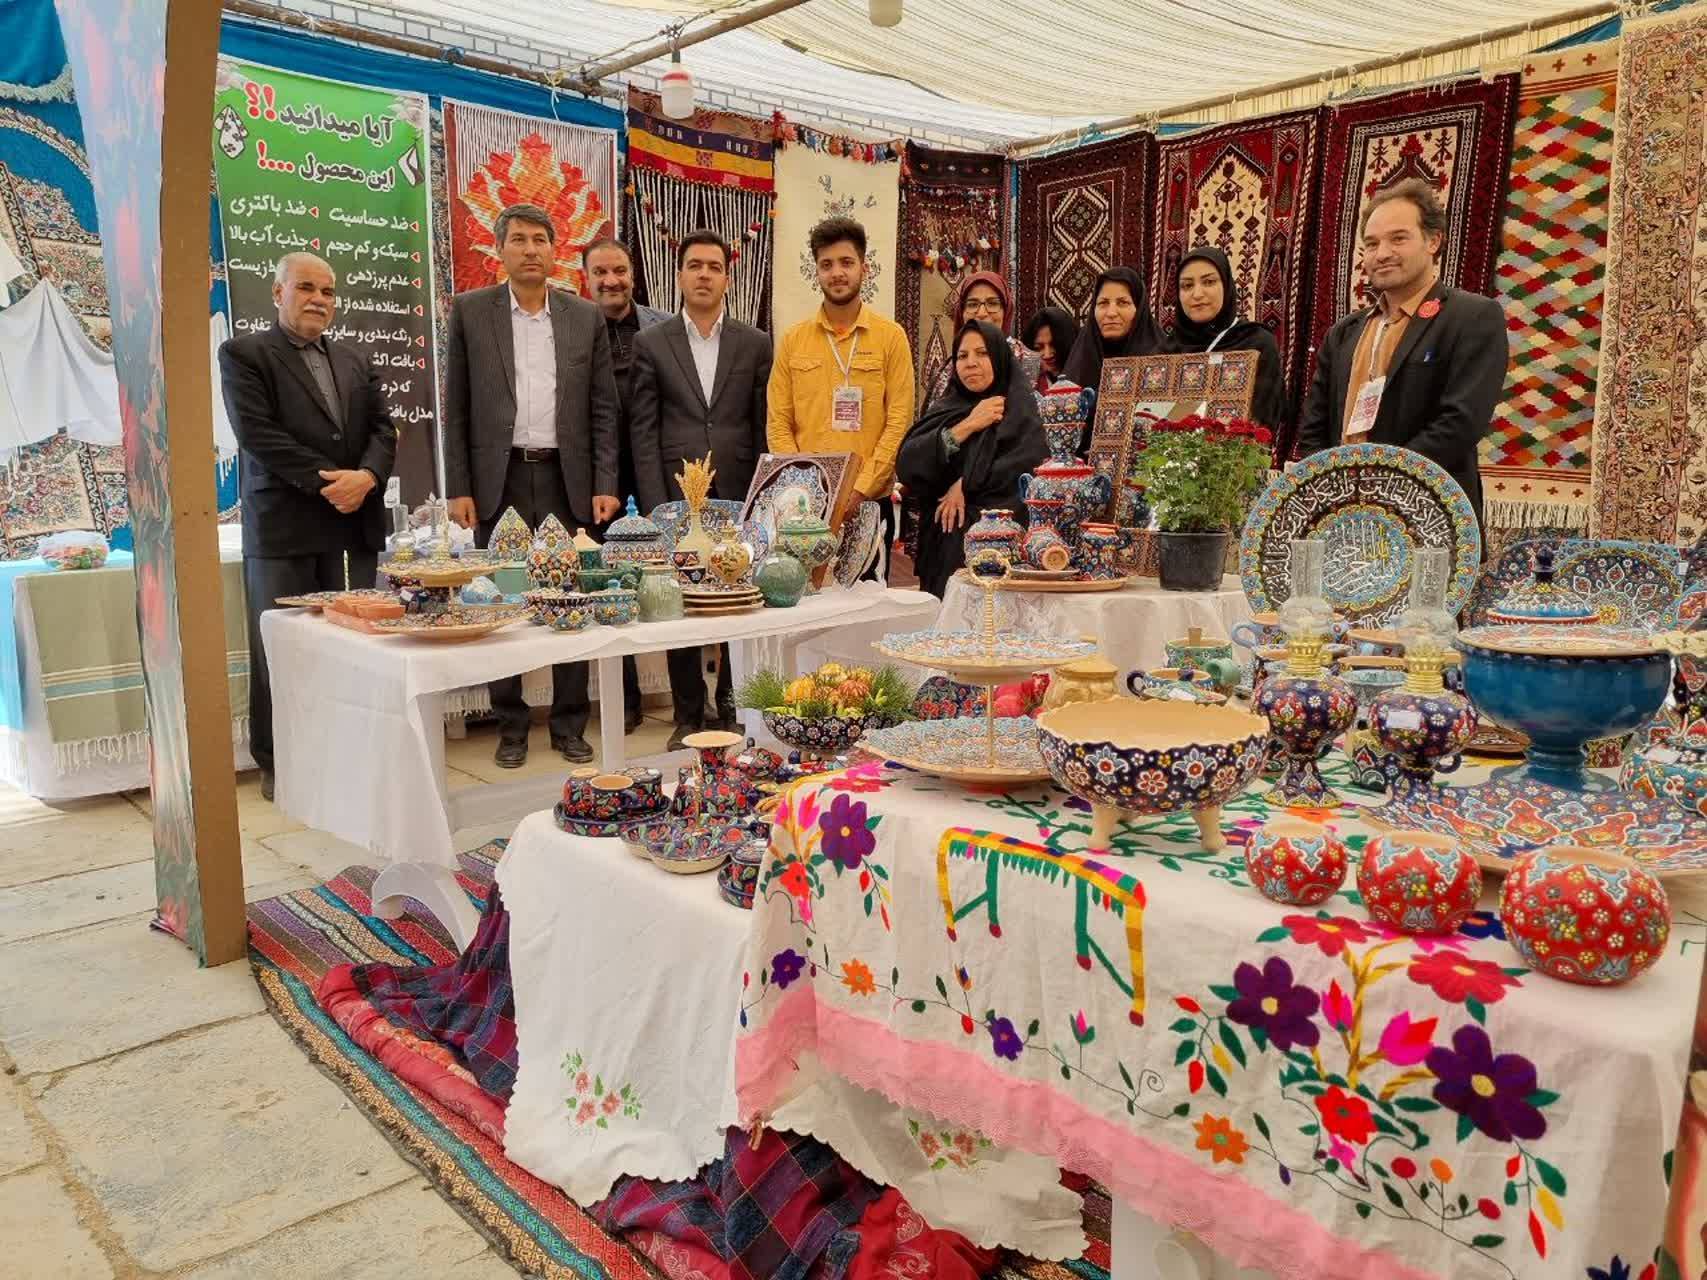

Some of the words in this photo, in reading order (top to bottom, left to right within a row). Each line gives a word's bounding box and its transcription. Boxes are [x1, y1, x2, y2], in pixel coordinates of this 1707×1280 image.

[363, 114, 394, 146] آیا
[300, 152, 365, 184] محصول
[367, 167, 395, 190] این
[230, 194, 281, 217] باکتری
[285, 199, 307, 215] ضد
[329, 206, 388, 228] حساسیت
[390, 215, 408, 231] ضد
[229, 225, 249, 243] بالا
[249, 224, 274, 245] آب
[275, 230, 308, 251] جذب
[326, 240, 354, 258] حجم
[354, 240, 371, 261] کم
[371, 247, 379, 260] و
[380, 243, 409, 262] سبک
[228, 257, 268, 279] زیست
[389, 274, 410, 291] عدم
[343, 296, 351, 314] از
[352, 297, 375, 311] شده
[376, 301, 410, 315] استفاده
[356, 331, 363, 343] و
[390, 354, 416, 371] بافت
[400, 380, 411, 392] که
[408, 405, 433, 423] مدل
